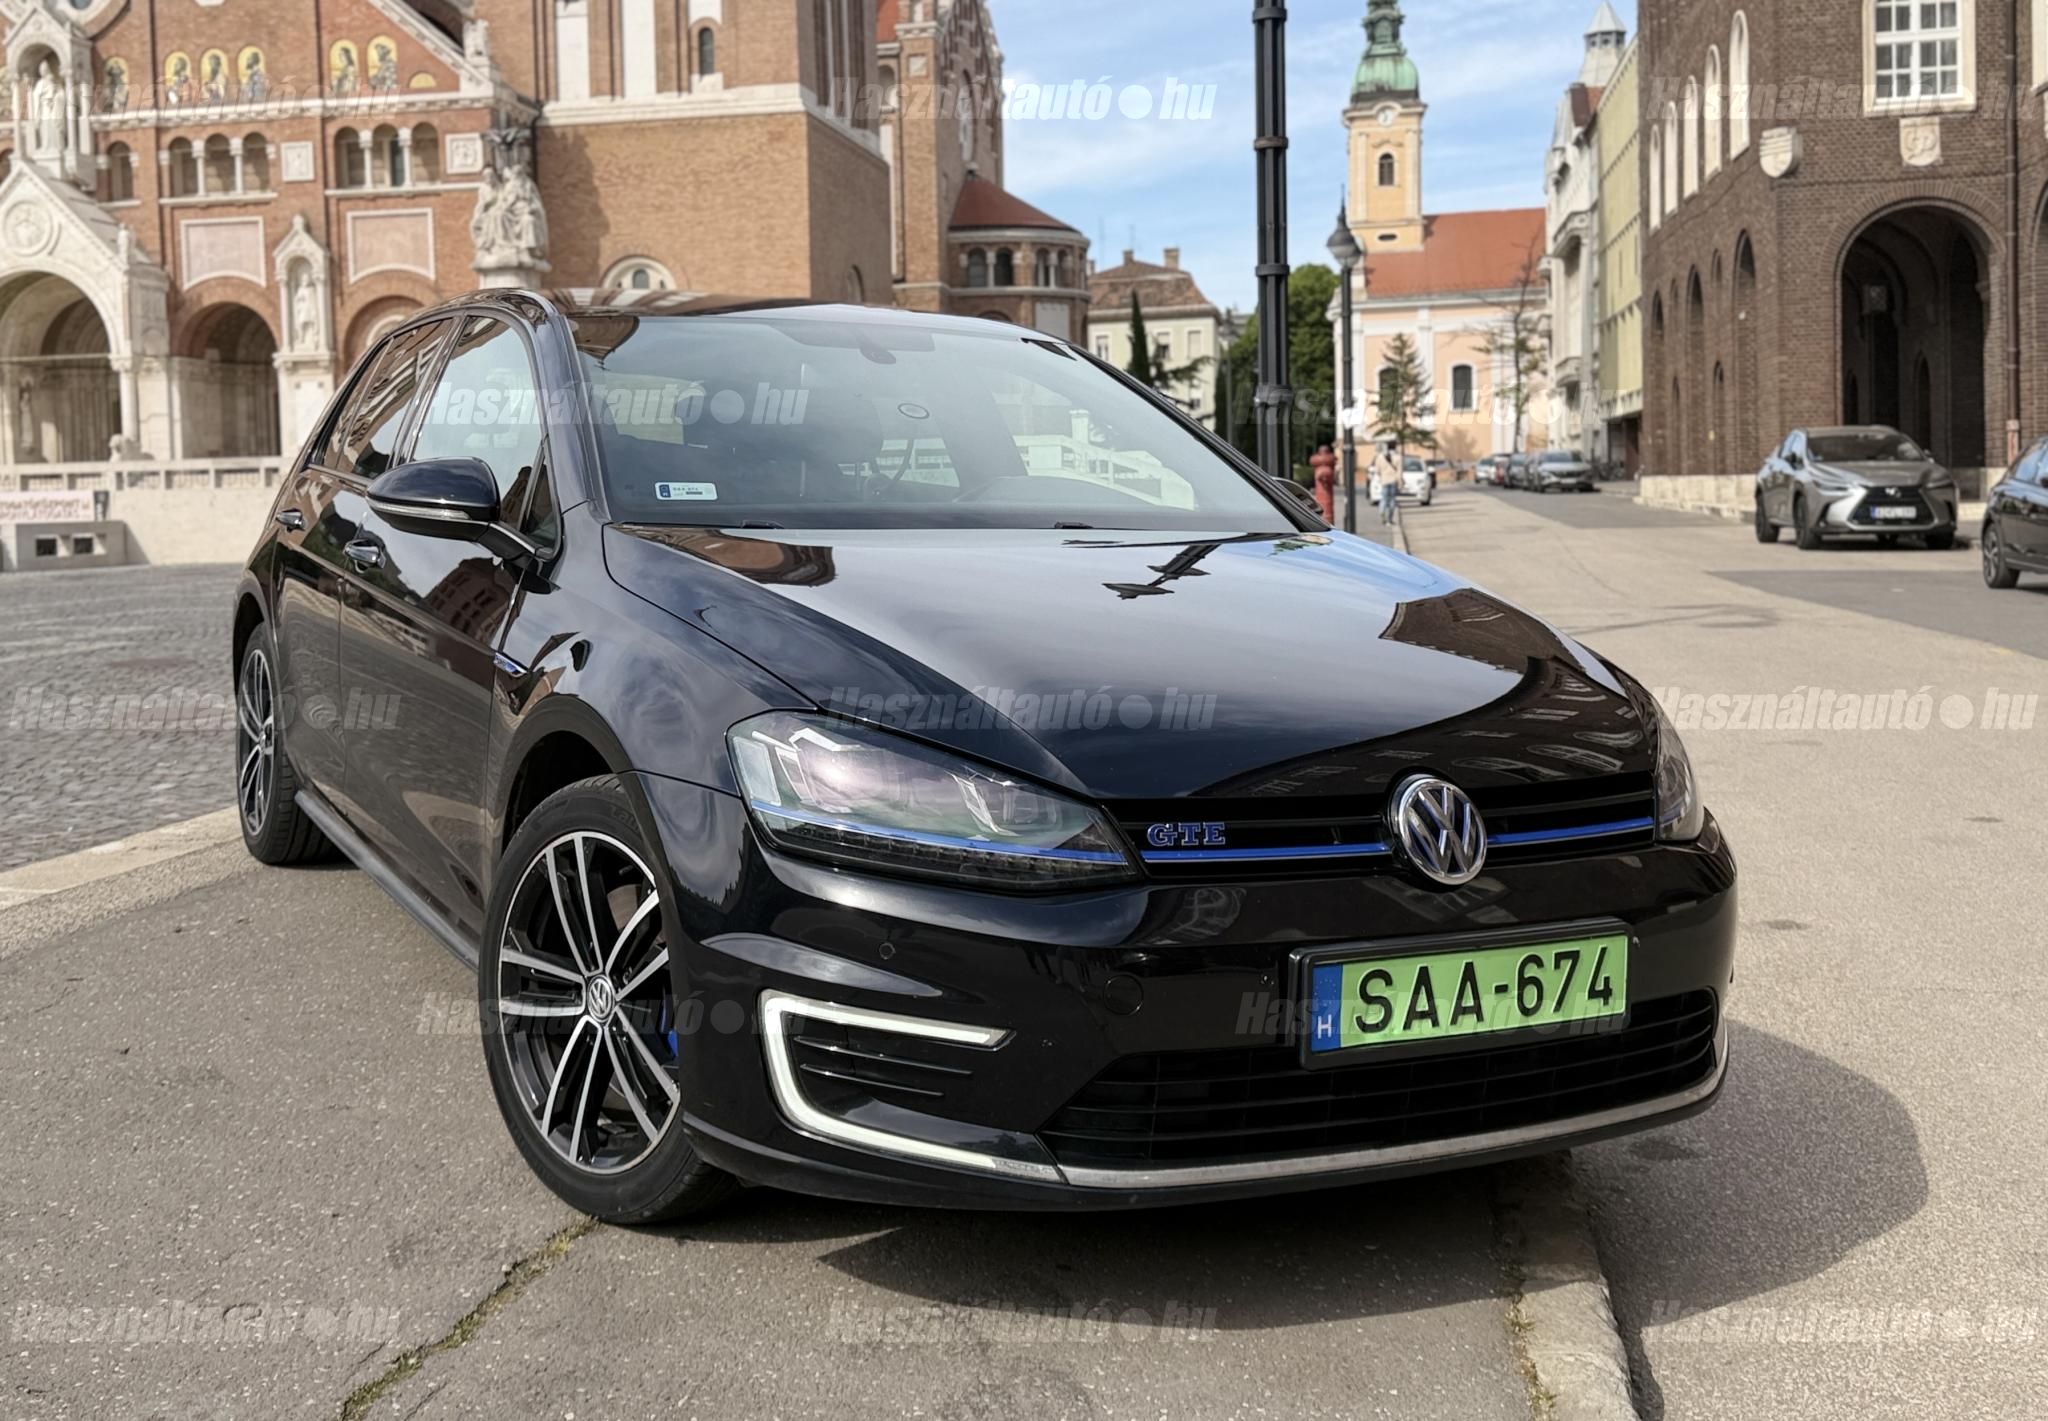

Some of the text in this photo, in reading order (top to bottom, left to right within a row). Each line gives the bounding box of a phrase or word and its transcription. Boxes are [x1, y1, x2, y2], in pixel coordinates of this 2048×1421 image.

[1147, 822, 1226, 846] GTE
[1355, 945, 1613, 1034] SAA-674
[1317, 1014, 1332, 1039] H
